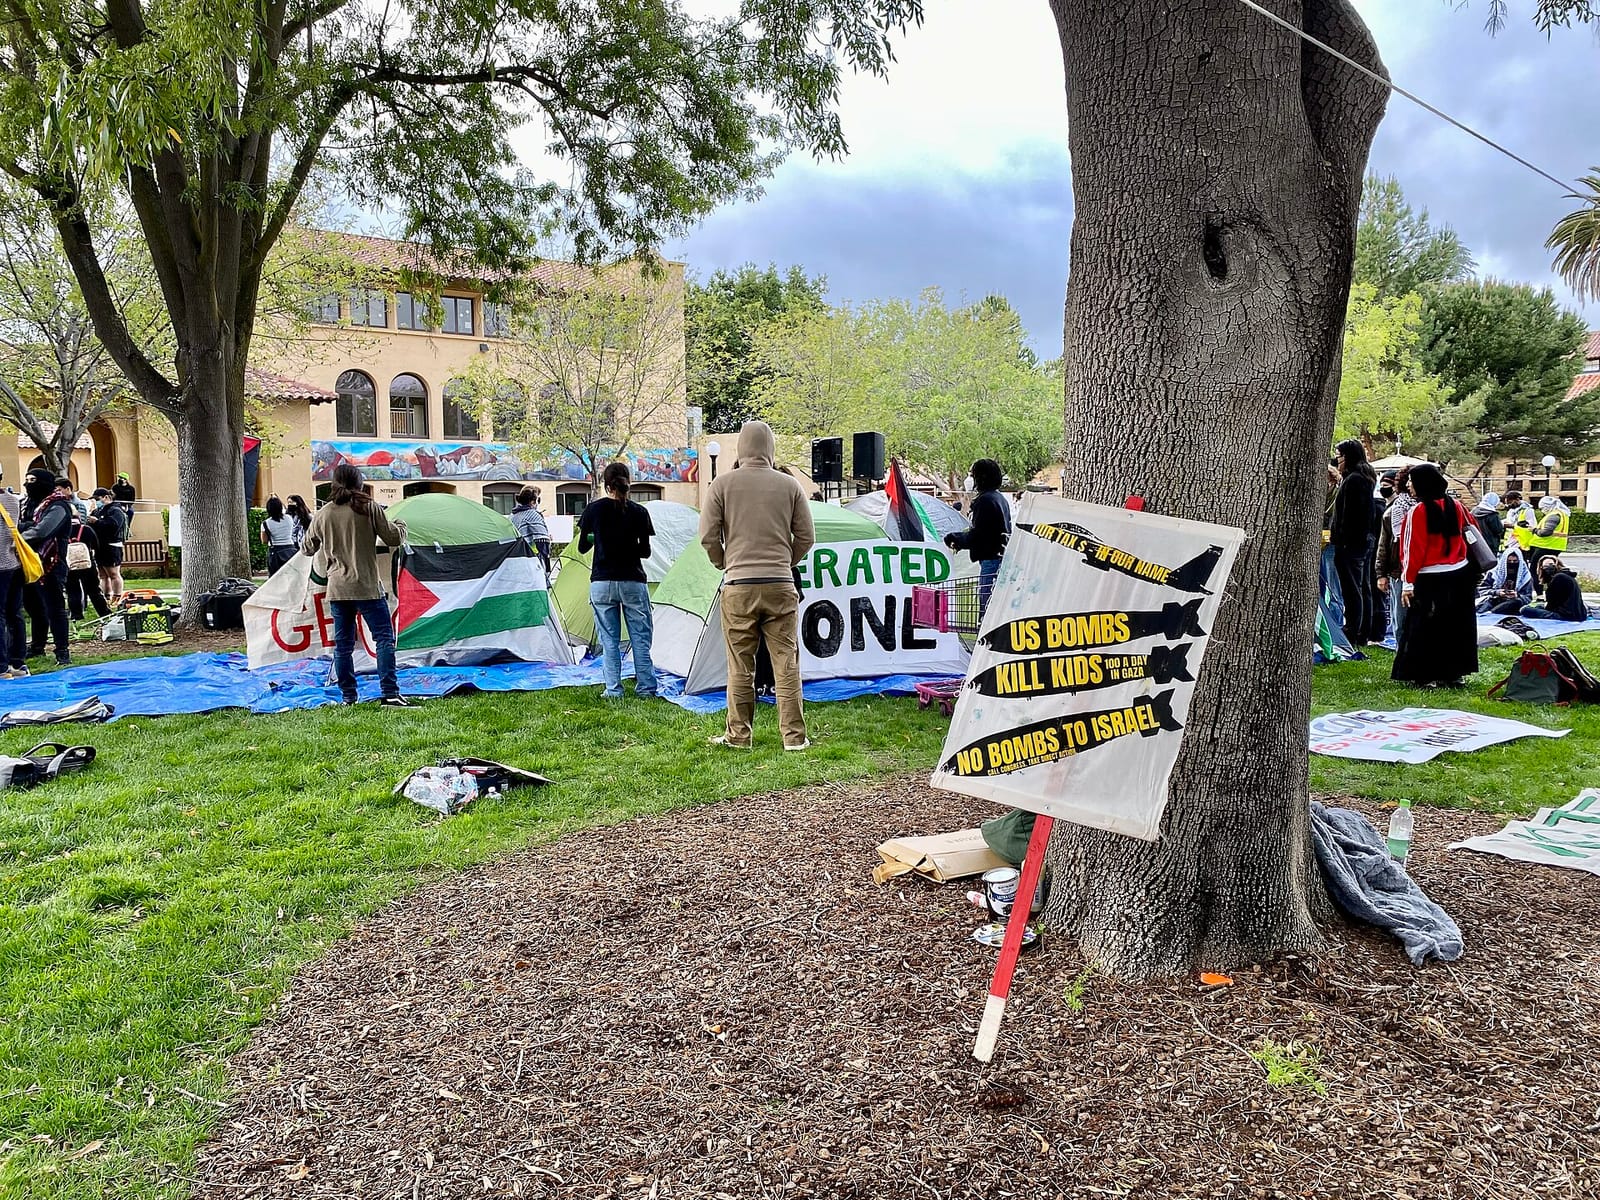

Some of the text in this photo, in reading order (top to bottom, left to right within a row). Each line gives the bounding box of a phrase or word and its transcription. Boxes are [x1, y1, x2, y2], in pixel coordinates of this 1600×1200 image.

[799, 546, 950, 588] ERATED
[1032, 522, 1054, 540] OUR
[1056, 529, 1078, 549] TAX
[1078, 539, 1087, 553] $
[1111, 550, 1136, 569] OUR
[1134, 559, 1171, 583] NAME
[802, 595, 937, 658] ONE
[1010, 613, 1130, 651] US BOMBS
[996, 655, 1103, 694] KILL KIDS
[1105, 655, 1148, 670] 100 A DAY
[1110, 666, 1144, 680] IN GAZA
[957, 704, 1160, 775] NO BOMBS TO ISRAEL
[1028, 757, 1040, 766] TAKE
